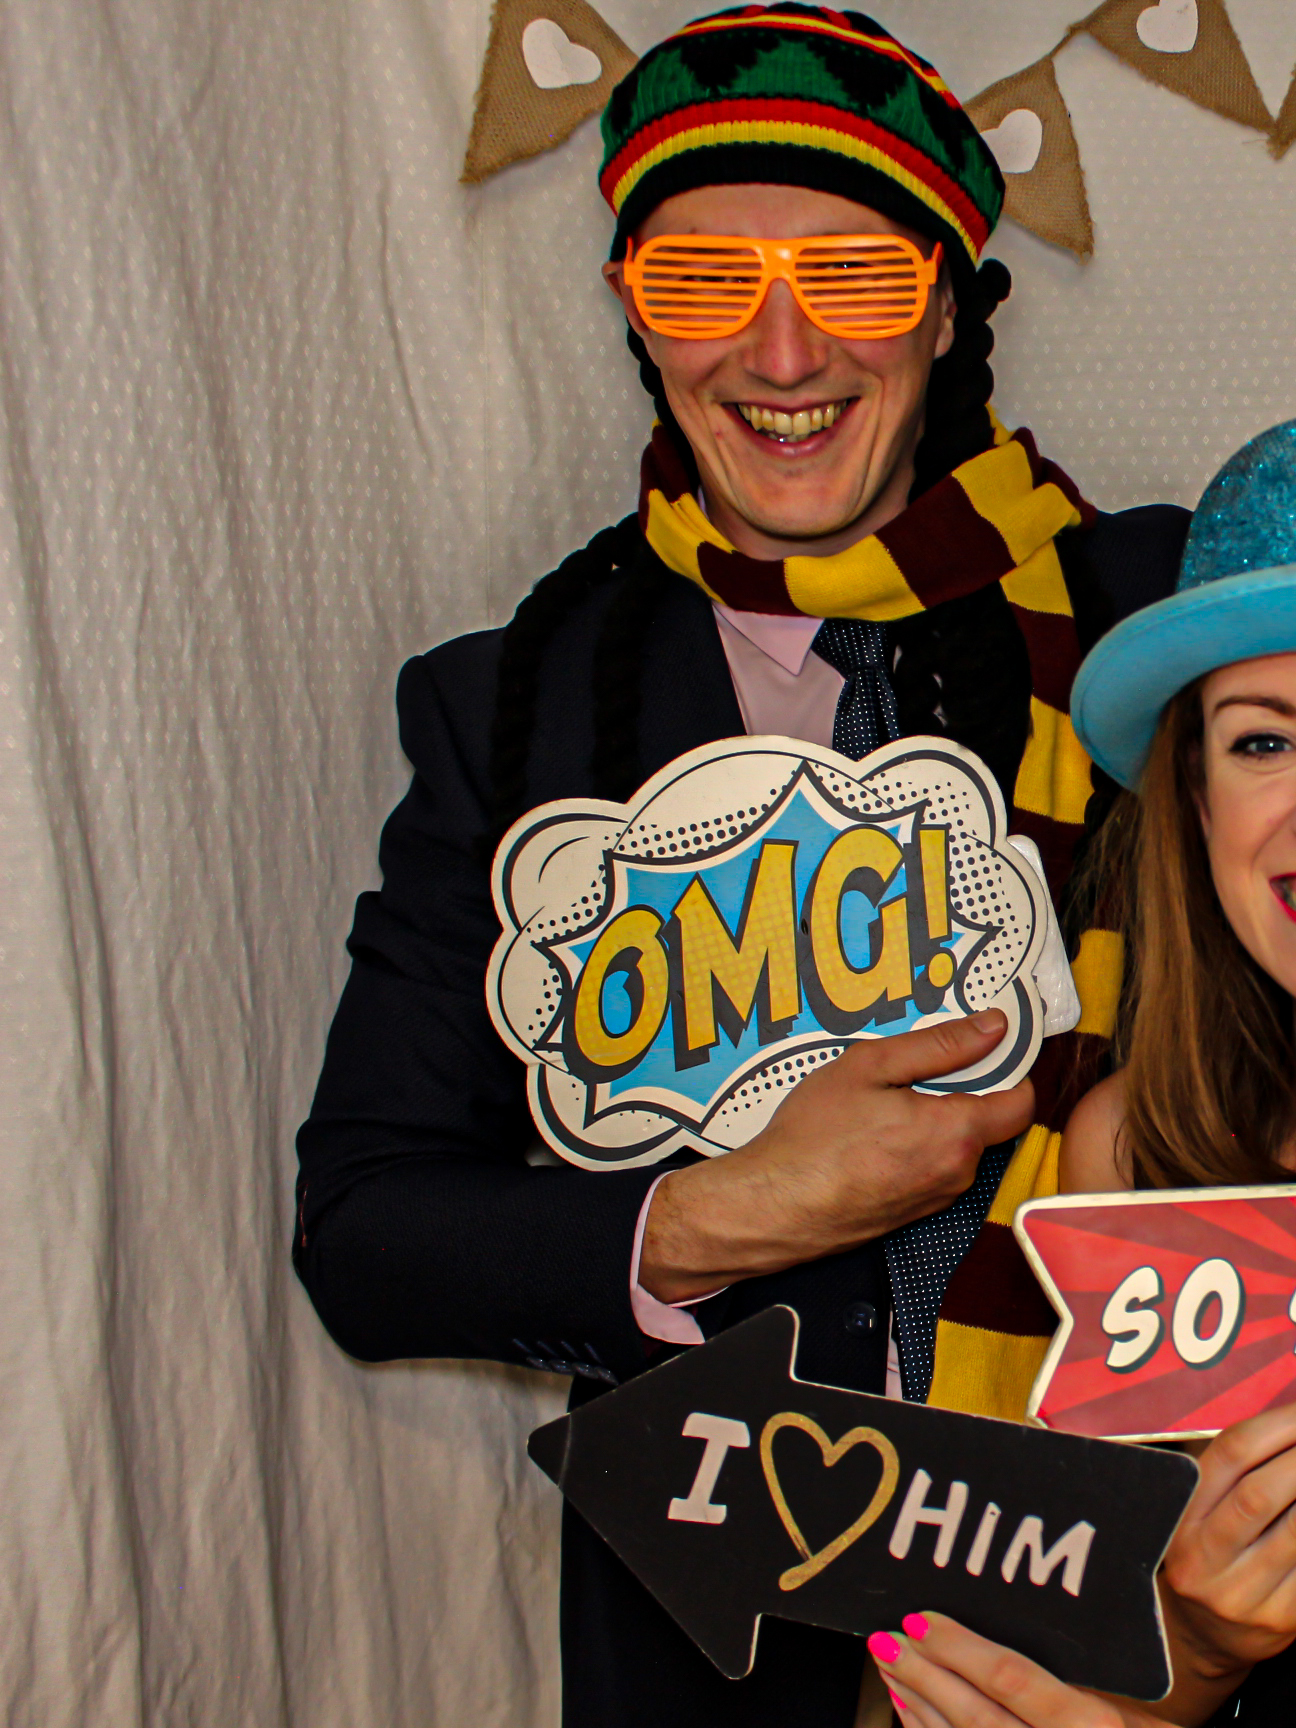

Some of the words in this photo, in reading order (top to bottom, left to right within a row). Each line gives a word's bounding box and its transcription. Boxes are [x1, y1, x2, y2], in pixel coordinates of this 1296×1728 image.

[566, 824, 959, 1078] OMG!
[1102, 1257, 1244, 1370] SO
[667, 1411, 751, 1525] I
[888, 1467, 1097, 1598] HIM
